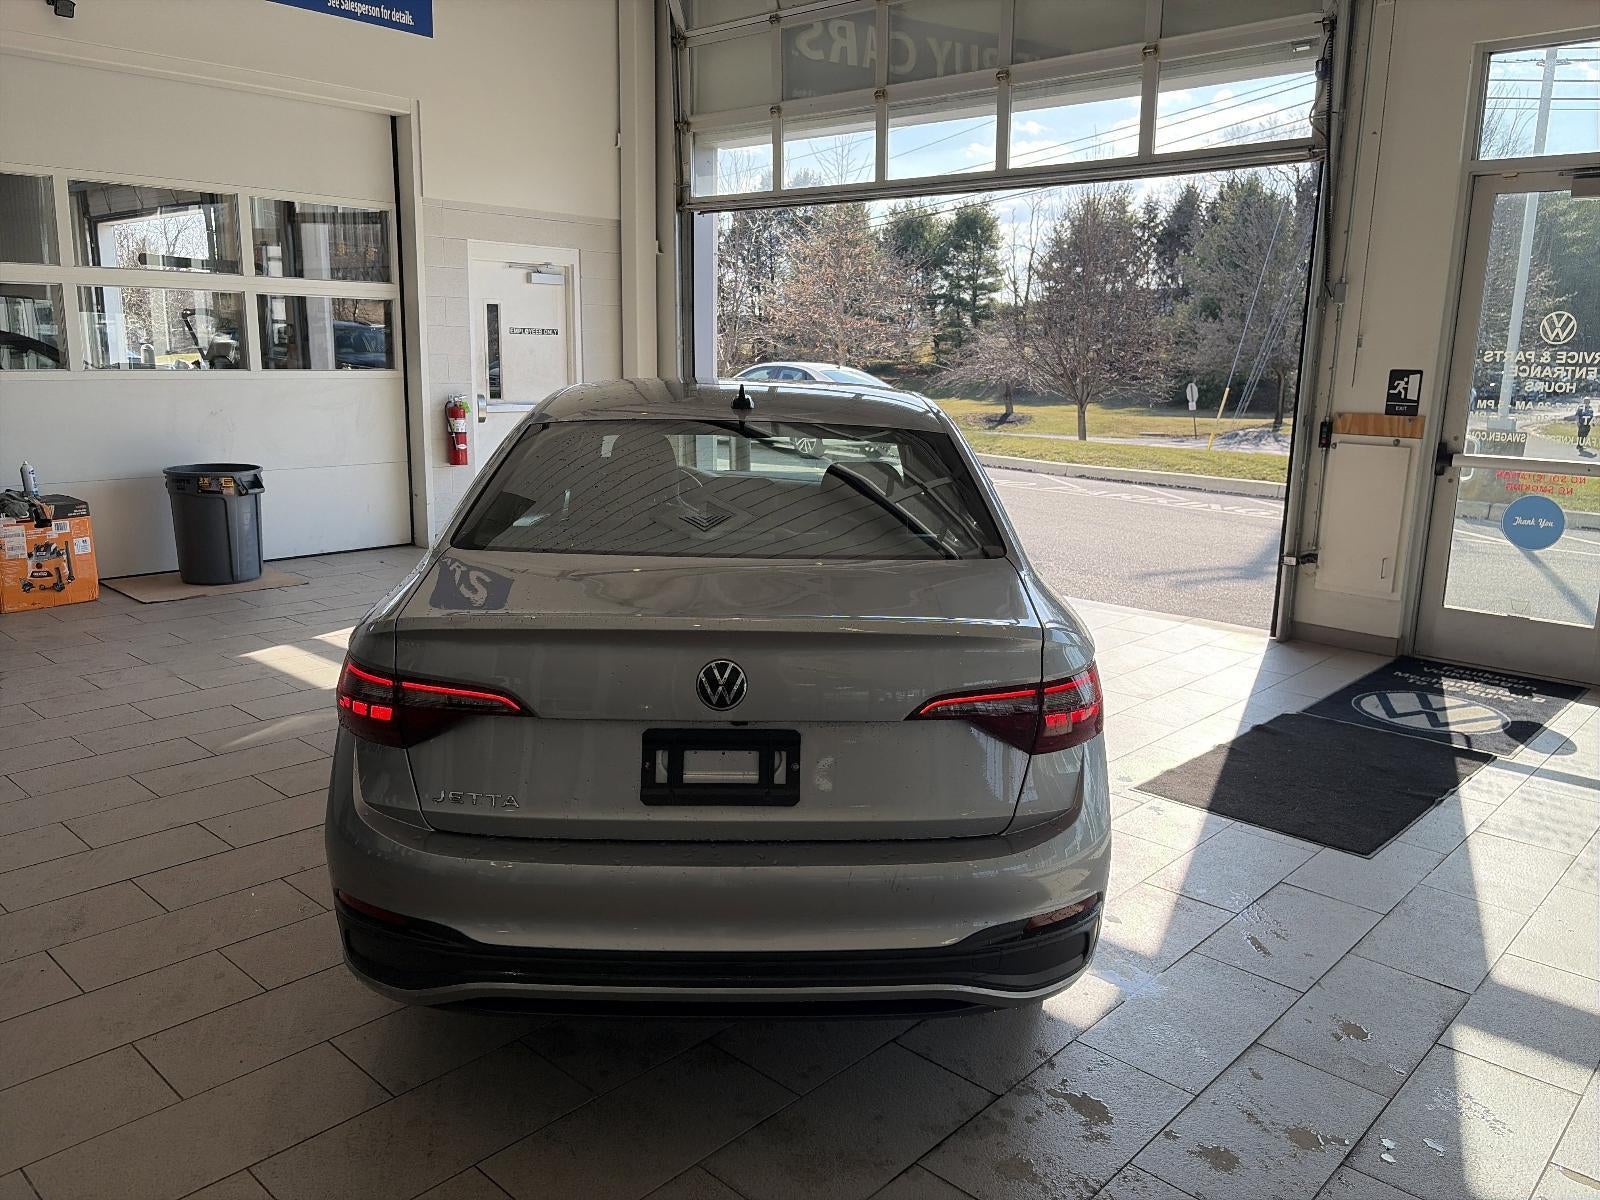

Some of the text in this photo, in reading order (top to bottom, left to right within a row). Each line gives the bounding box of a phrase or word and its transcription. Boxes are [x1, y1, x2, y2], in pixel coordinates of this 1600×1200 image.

[327, 0, 415, 25] See Salesperson for details.
[510, 327, 558, 336] EMPLOYEES ONLY
[1513, 516, 1554, 528] Thank You
[432, 790, 520, 808] JETTA
